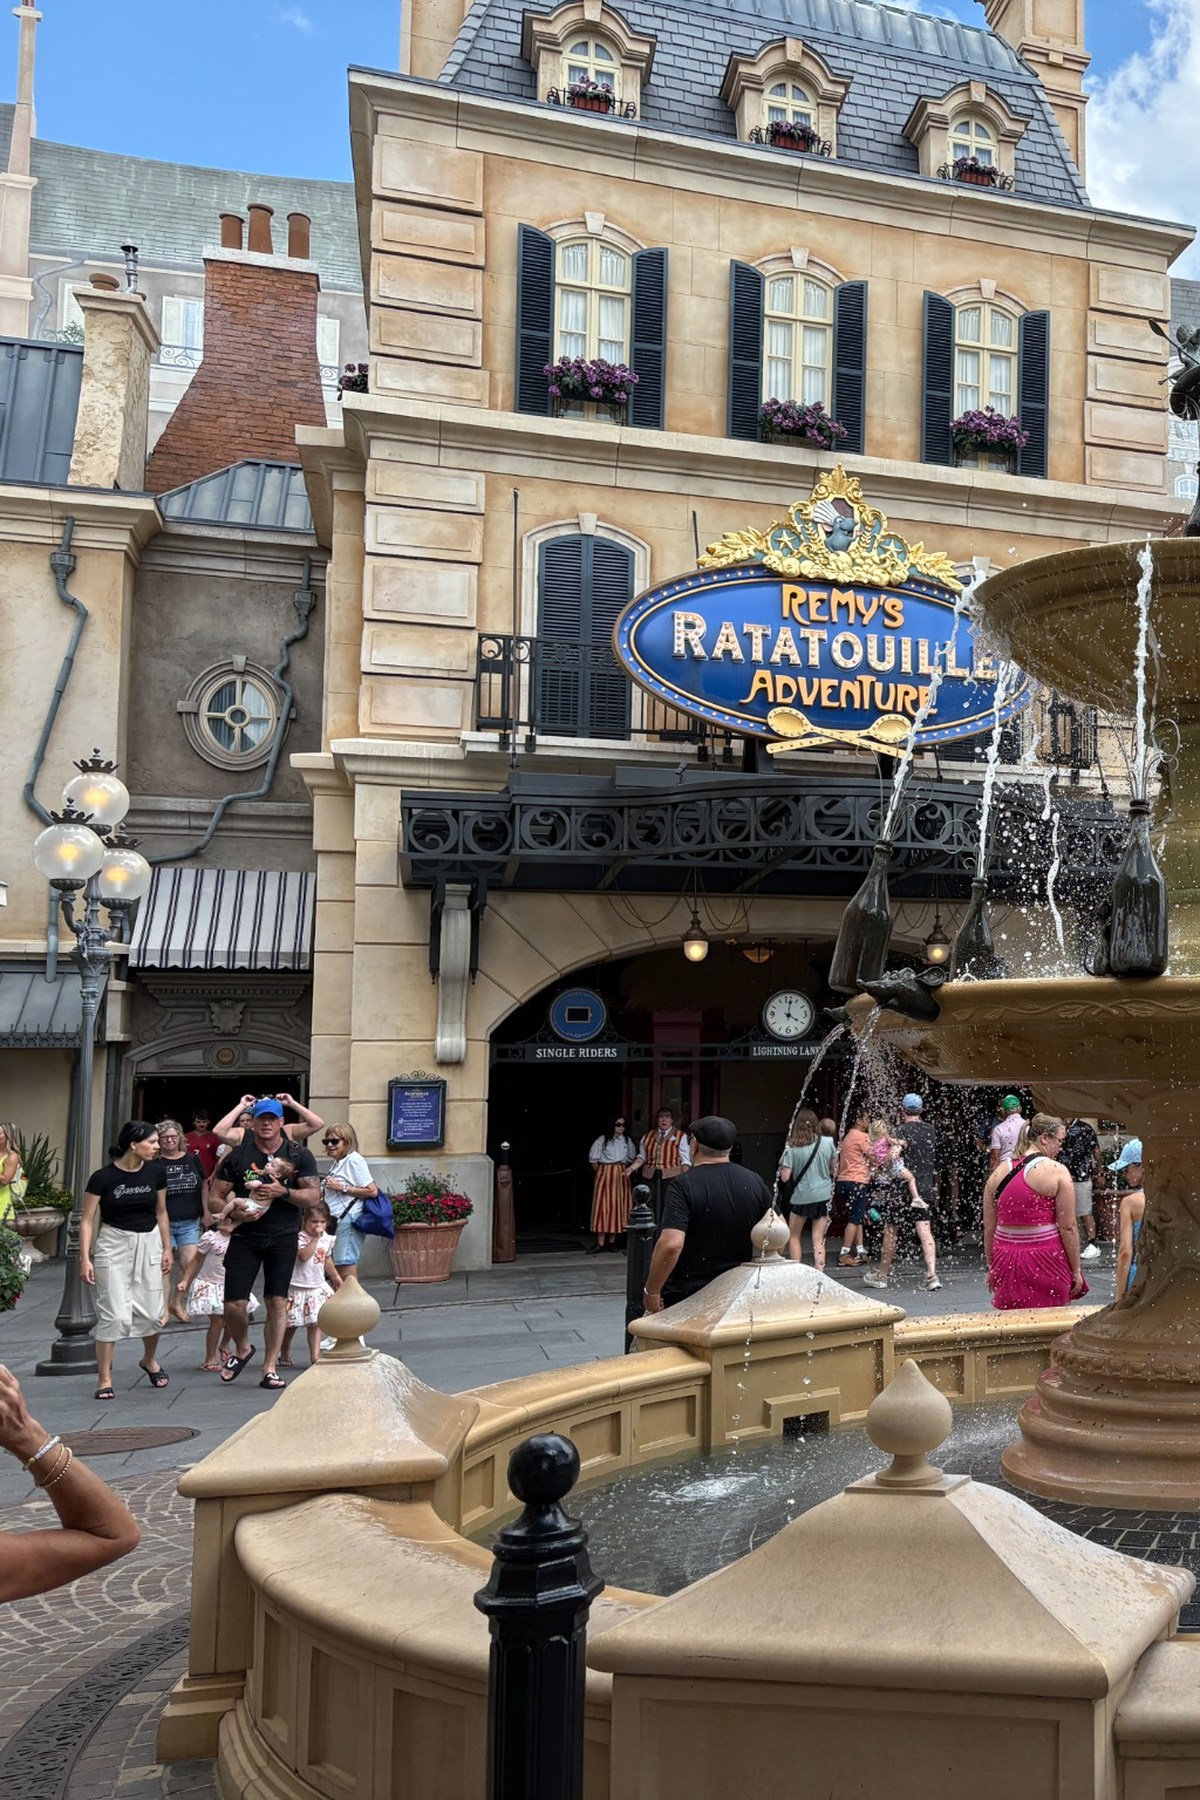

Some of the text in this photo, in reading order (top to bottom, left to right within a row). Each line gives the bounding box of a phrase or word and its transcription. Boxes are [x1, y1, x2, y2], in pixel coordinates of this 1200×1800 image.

[781, 583, 905, 629] REMY'S
[739, 669, 939, 716] ADVENTURE
[769, 1011, 776, 1019] 9
[803, 1010, 808, 1019] 3
[785, 1026, 792, 1034] 6
[536, 1047, 618, 1059] SINGLE RIDERS
[752, 1046, 798, 1056] LIGHTNING
